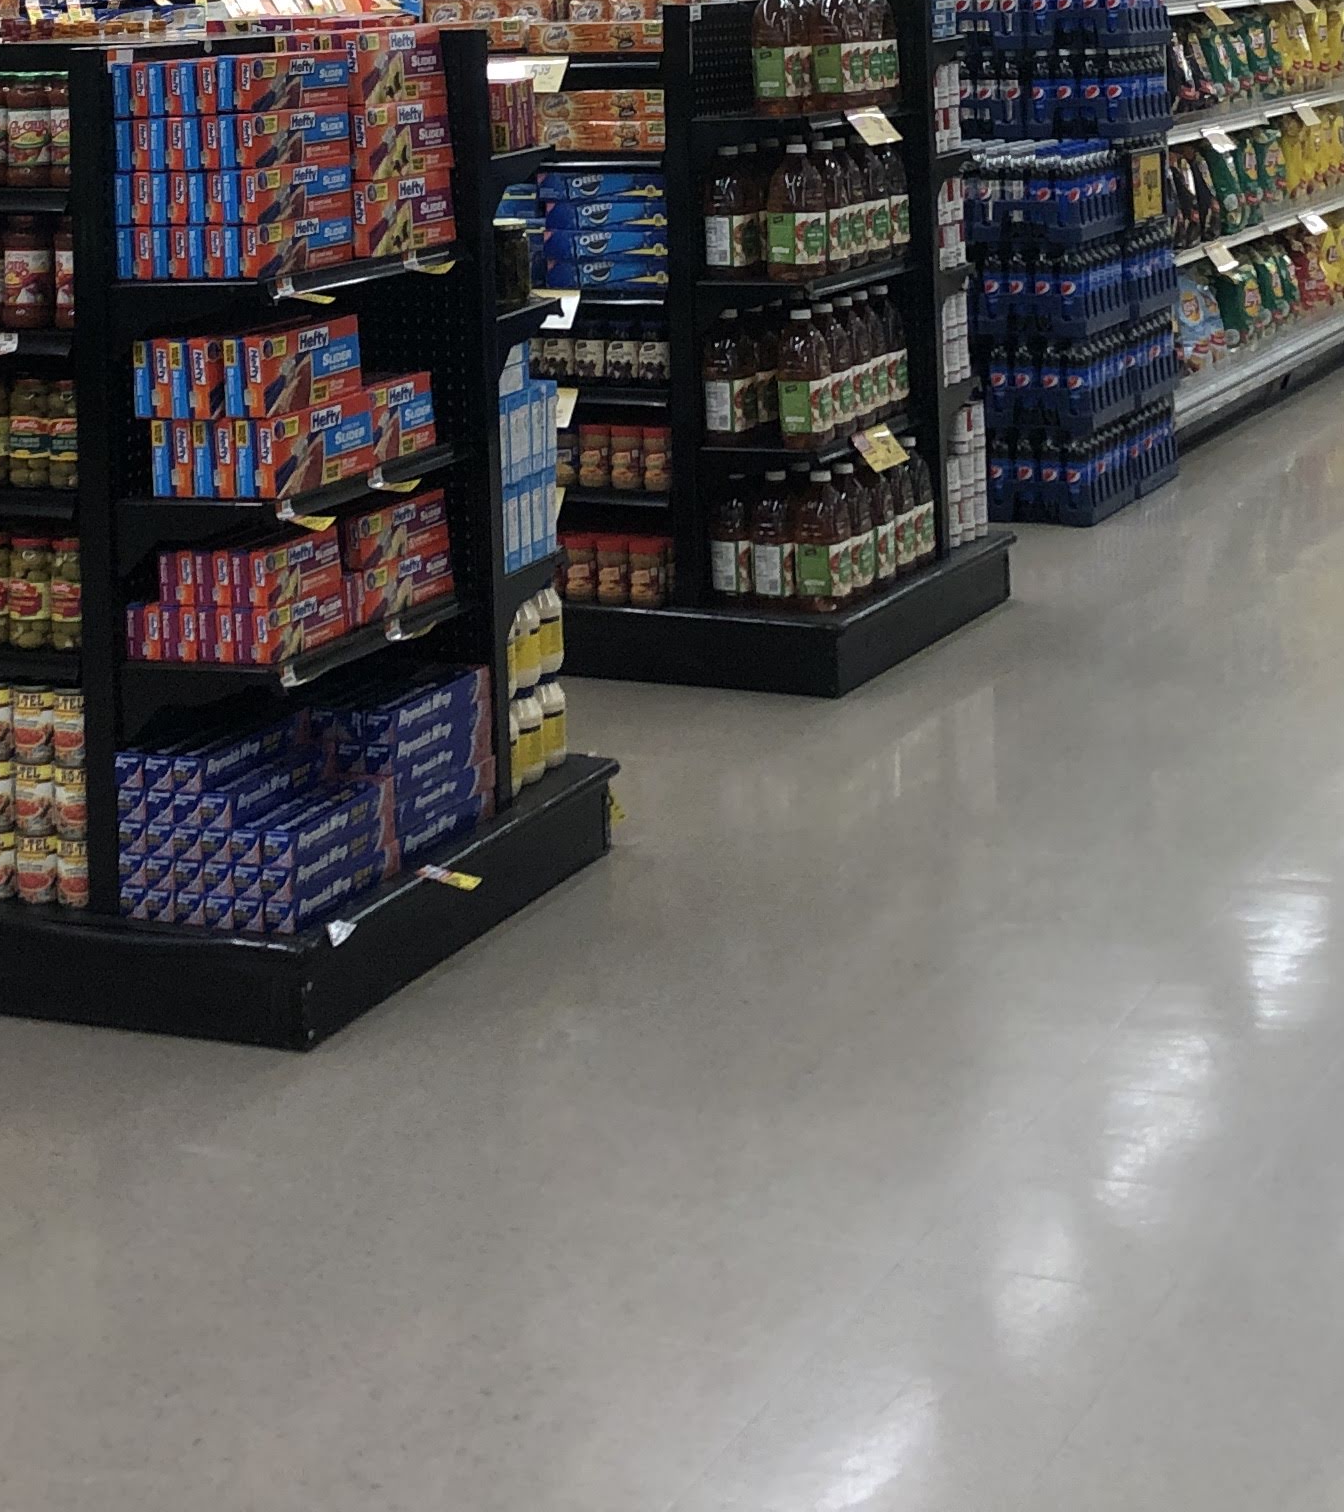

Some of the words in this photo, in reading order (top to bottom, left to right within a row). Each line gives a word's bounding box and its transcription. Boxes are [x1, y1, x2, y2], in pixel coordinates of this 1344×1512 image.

[389, 31, 416, 50] Hefty
[290, 57, 315, 75] Hefty
[291, 112, 316, 129] Hefty
[397, 102, 424, 124] Hefty
[294, 166, 319, 184] Hefty
[571, 173, 605, 189] OREO
[399, 177, 426, 199] Hefty
[580, 202, 613, 216] OREO
[294, 218, 320, 236] Hefty
[579, 231, 613, 246] OREO
[582, 261, 615, 276] OREO
[298, 326, 329, 353] Hefty
[388, 381, 415, 405] Hefty
[311, 404, 342, 433] Hefty
